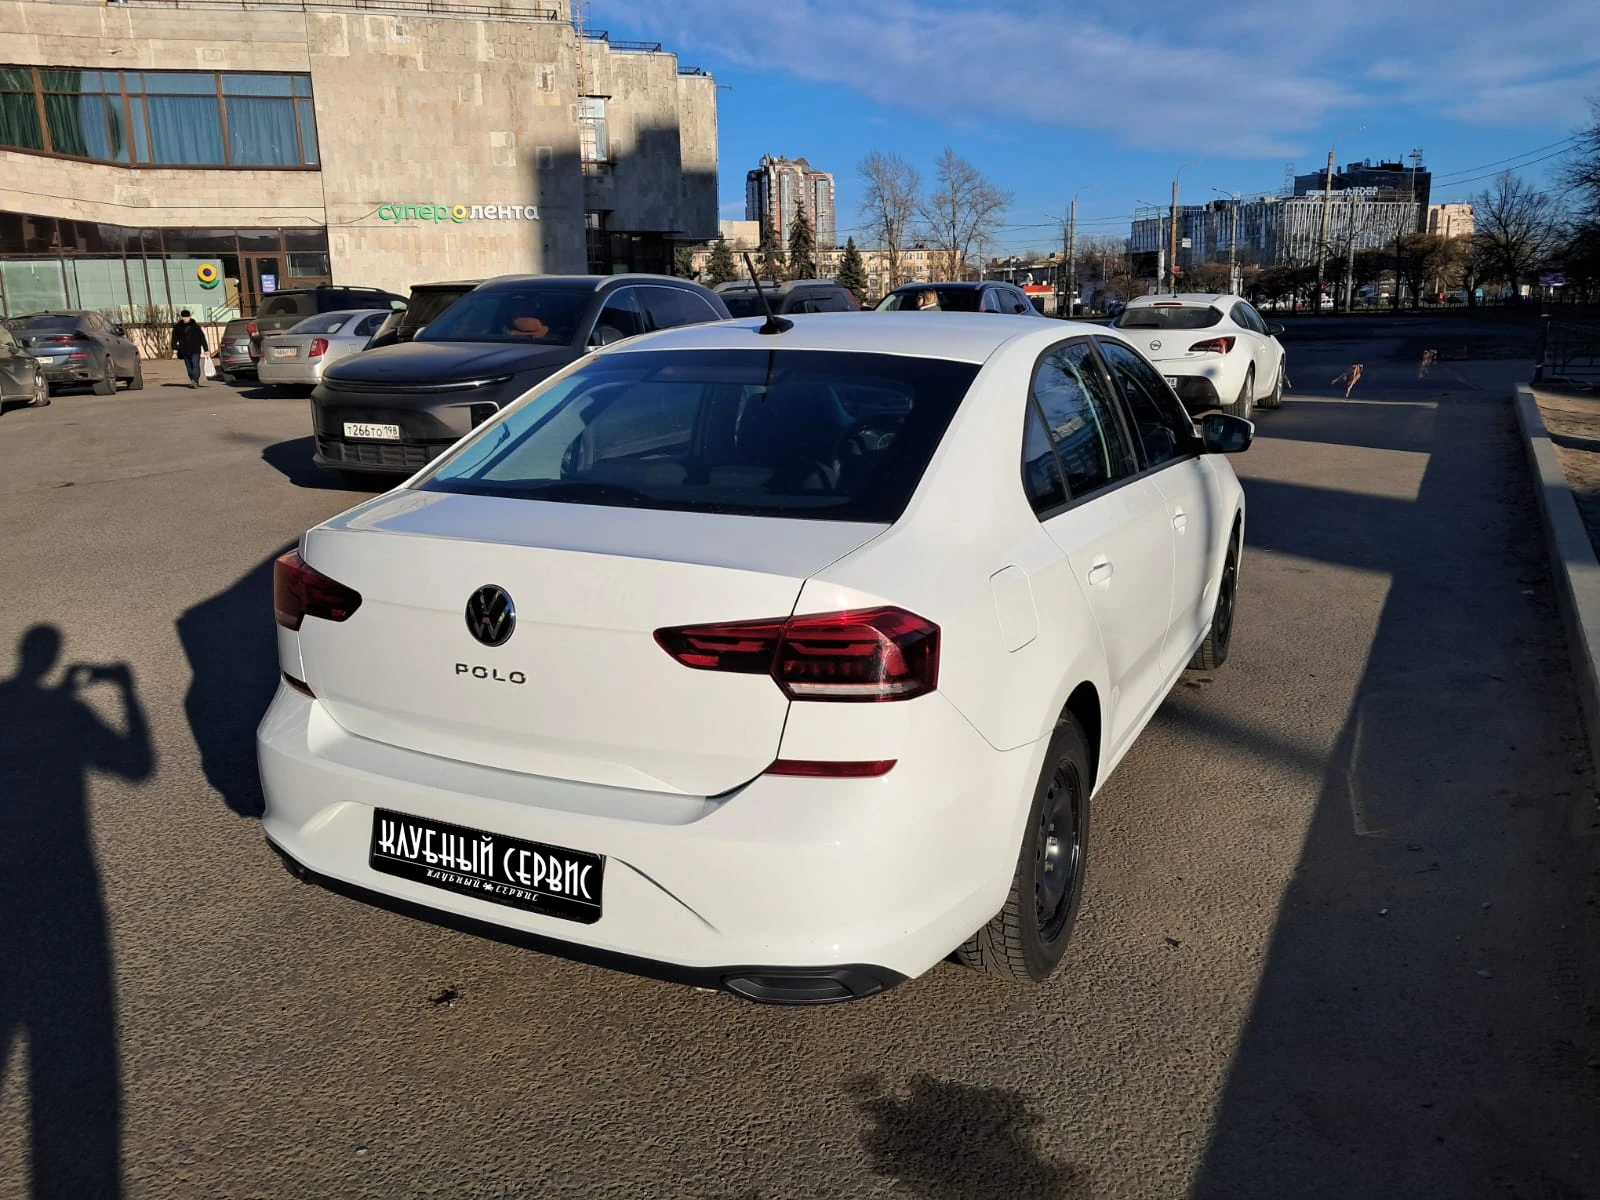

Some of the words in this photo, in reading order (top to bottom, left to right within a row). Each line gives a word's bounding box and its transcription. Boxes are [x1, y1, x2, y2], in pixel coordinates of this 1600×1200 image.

[378, 204, 449, 224] супер
[469, 204, 540, 221] лента
[455, 662, 527, 685] POLO
